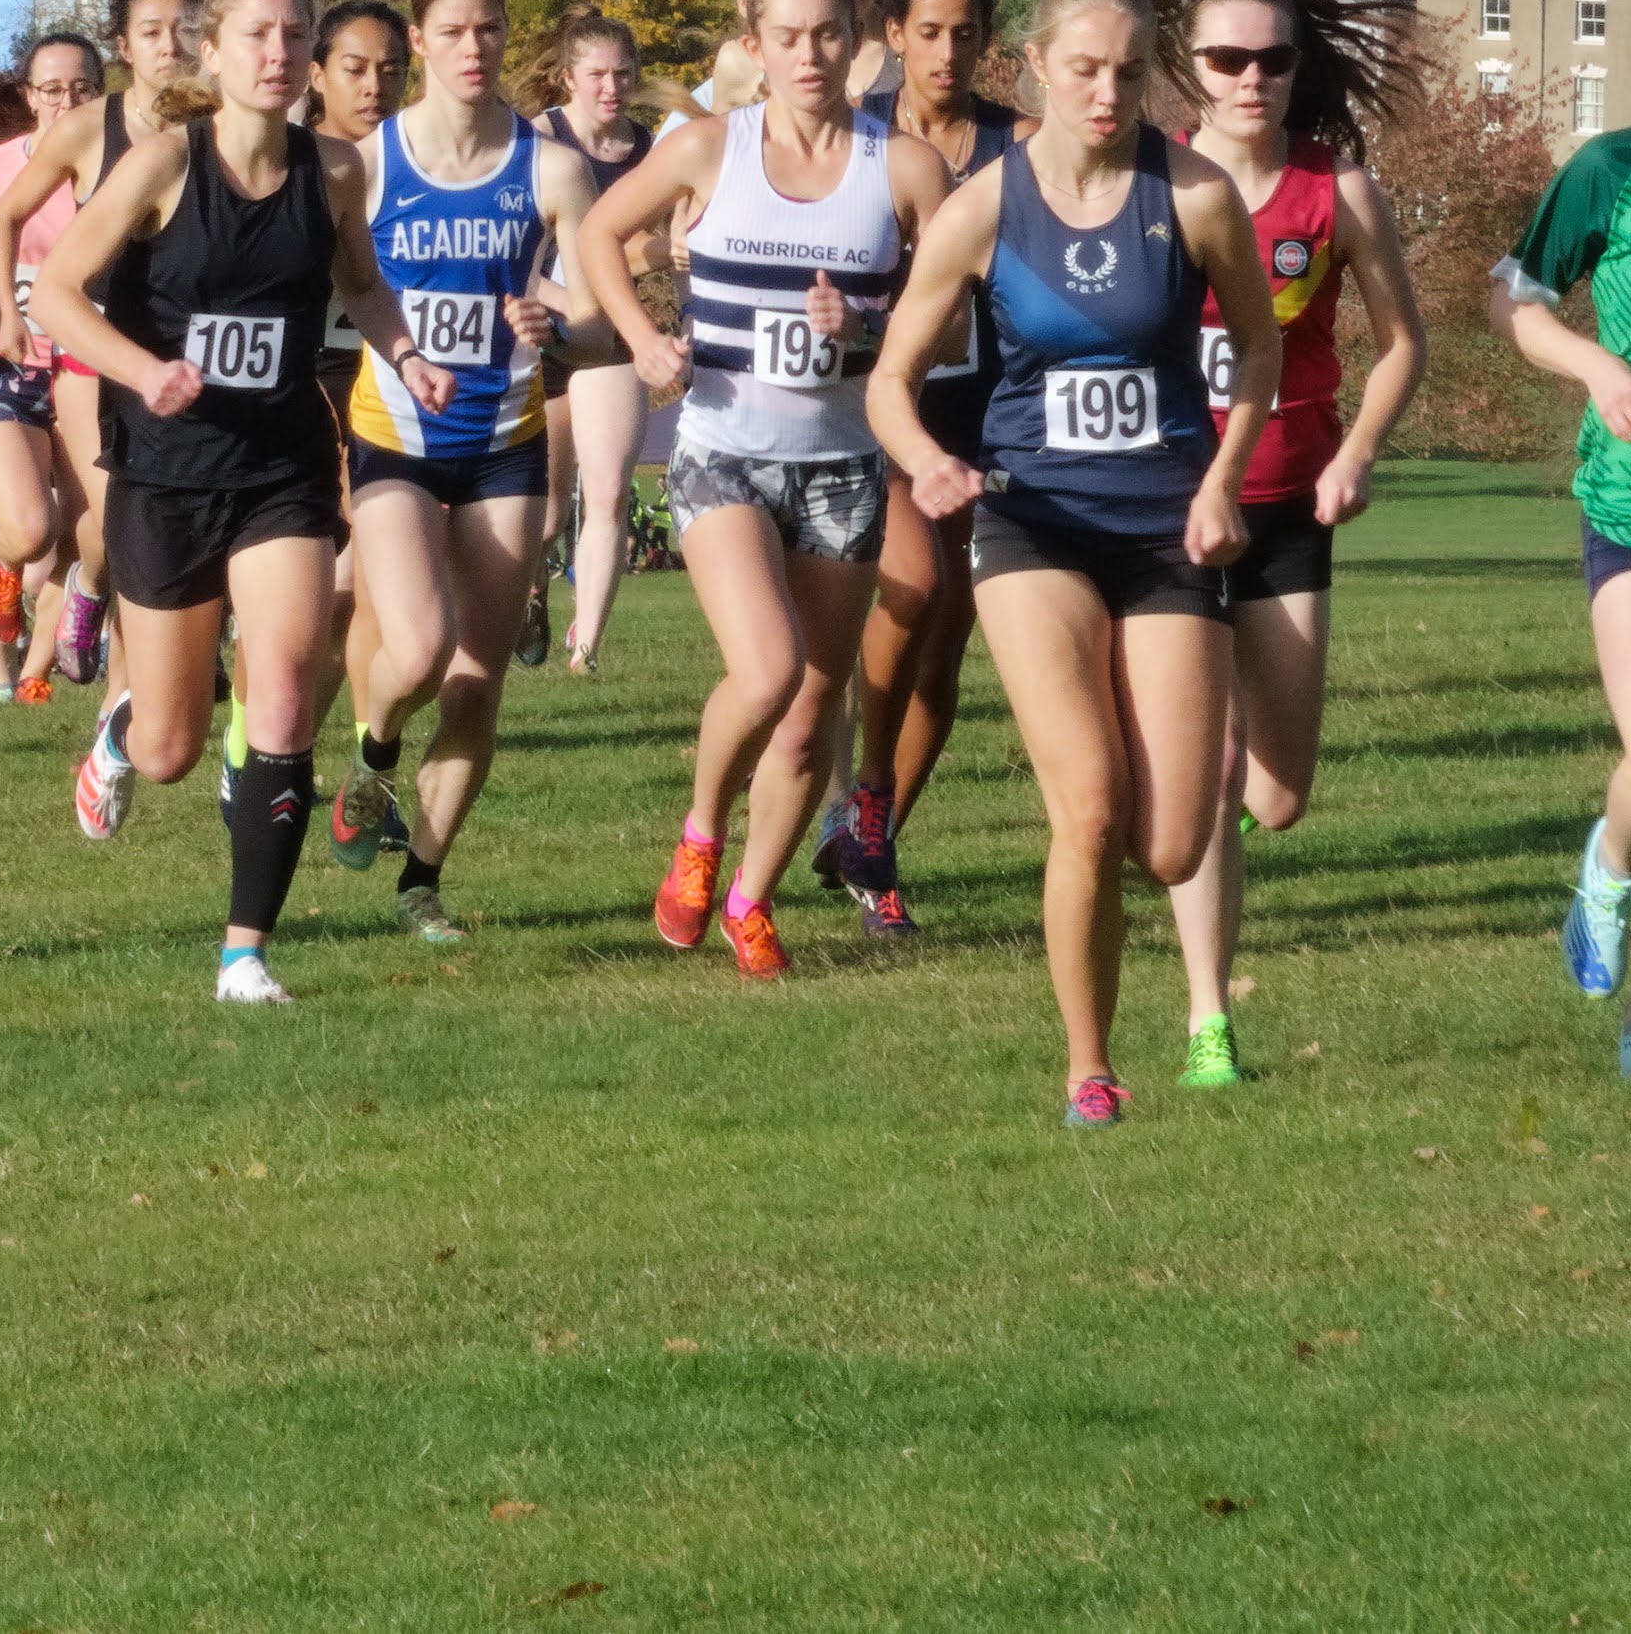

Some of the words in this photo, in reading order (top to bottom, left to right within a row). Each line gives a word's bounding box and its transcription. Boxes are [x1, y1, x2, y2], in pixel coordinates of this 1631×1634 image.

[391, 218, 530, 261] ACADEMY
[724, 237, 839, 261] TONBRIDGE
[844, 249, 870, 264] AC
[197, 320, 274, 379] 105
[411, 297, 485, 354] 184
[1056, 374, 1147, 440] 199
